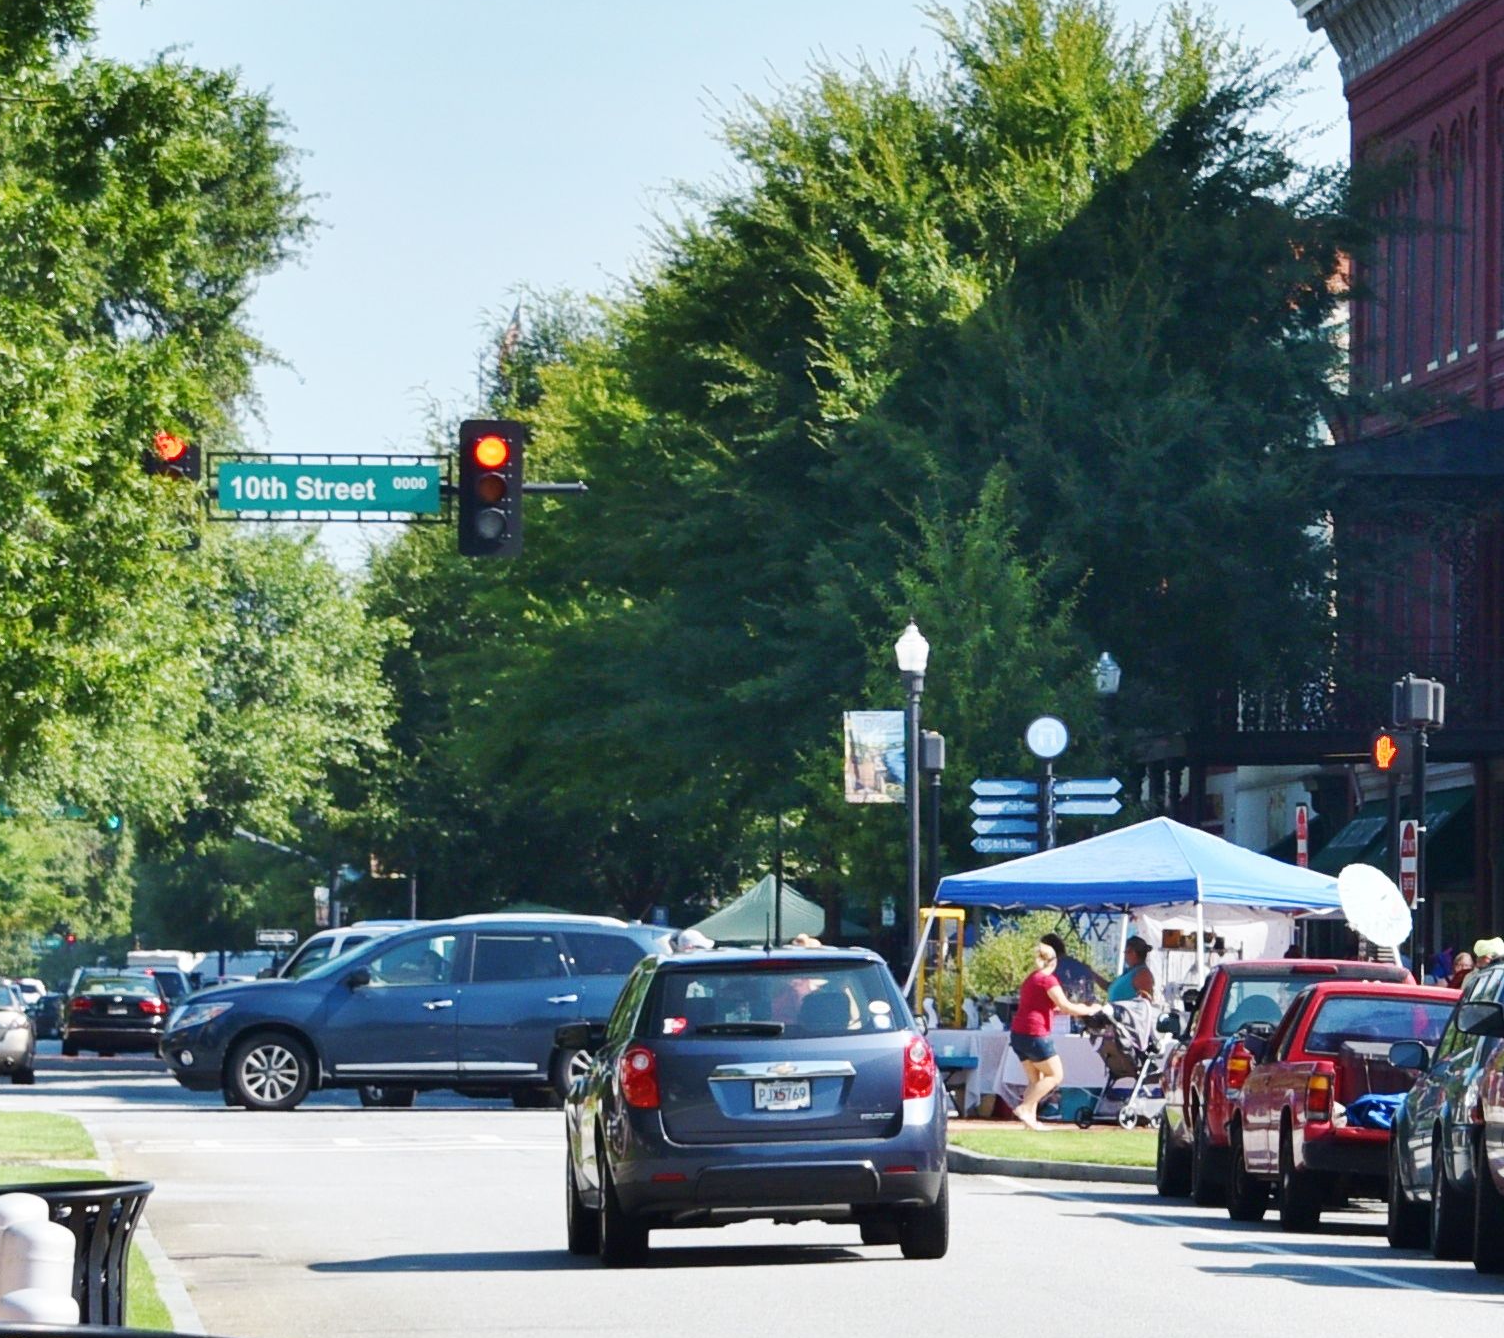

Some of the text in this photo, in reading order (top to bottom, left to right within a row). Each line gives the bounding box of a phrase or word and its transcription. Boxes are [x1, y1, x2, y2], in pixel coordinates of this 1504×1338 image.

[231, 476, 427, 500] 10th Street 0000
